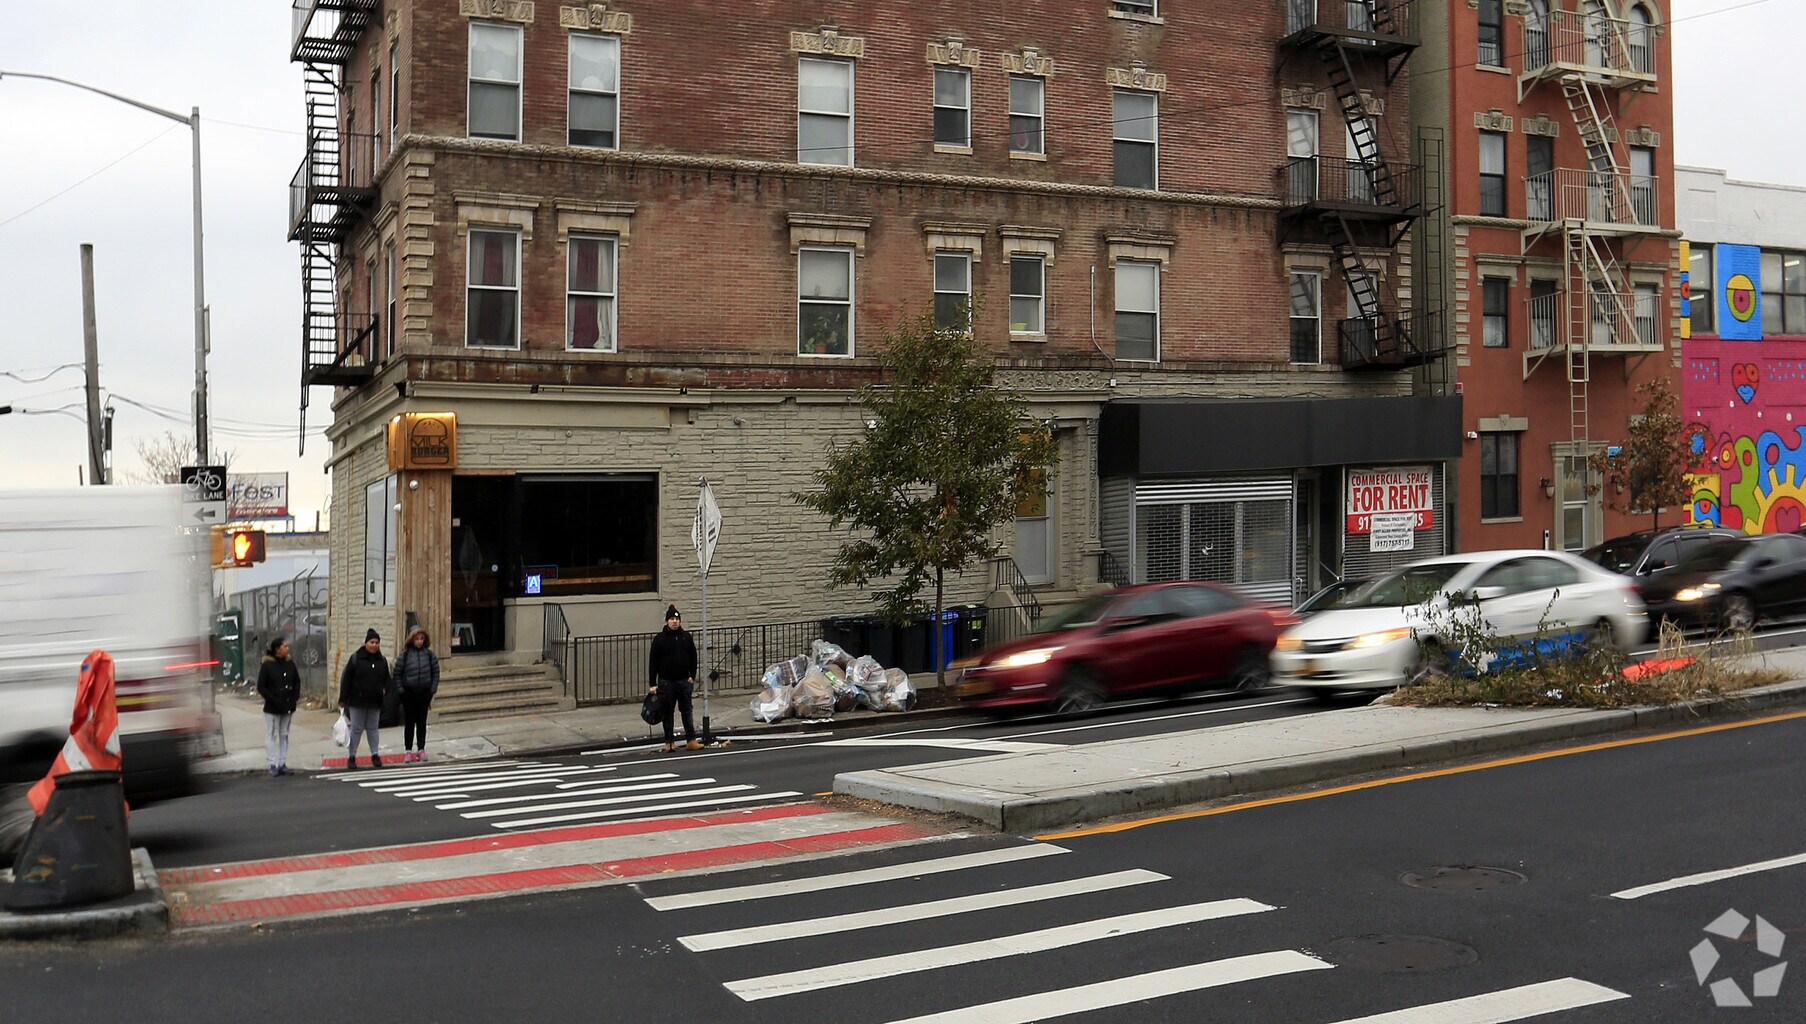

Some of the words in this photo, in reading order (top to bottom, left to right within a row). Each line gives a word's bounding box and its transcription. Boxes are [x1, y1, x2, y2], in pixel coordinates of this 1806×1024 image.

[411, 447, 449, 456] BURGER
[1351, 473, 1402, 486] COMMERCIAL
[1406, 472, 1429, 484] SPACE
[203, 491, 224, 500] LANE
[1352, 486, 1385, 512] FOR
[1388, 484, 1429, 510] RENT
[529, 576, 538, 588] A
